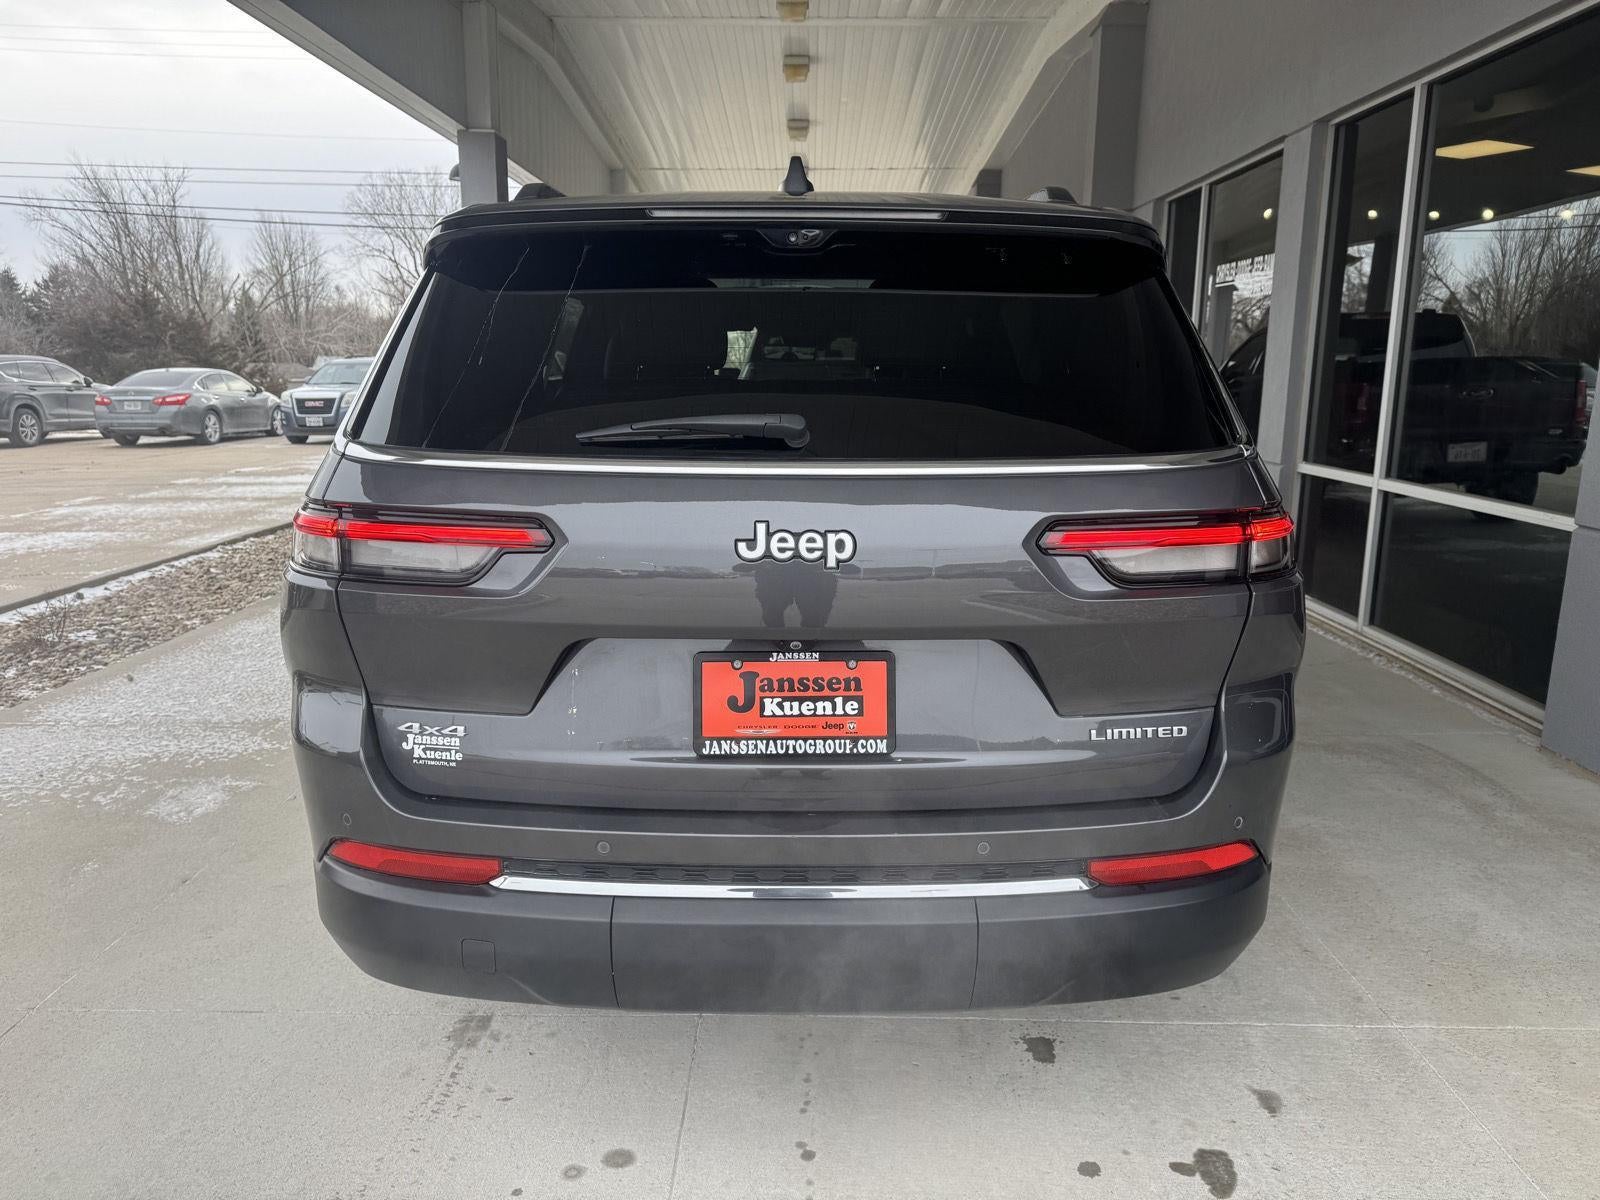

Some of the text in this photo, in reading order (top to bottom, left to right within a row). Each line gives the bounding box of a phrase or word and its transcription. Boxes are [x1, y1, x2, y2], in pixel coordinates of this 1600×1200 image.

[735, 520, 857, 570] Jeep
[769, 652, 820, 662] JANSSEN
[726, 671, 863, 714] Janssen
[762, 697, 859, 717] Kuenle
[397, 722, 468, 737] 4x4
[821, 721, 845, 731] Jeep
[1089, 725, 1188, 741] LIMITED
[401, 733, 460, 750] Janssen
[702, 739, 888, 755] JANSSENAUTOGROUP.COM
[412, 744, 463, 761] Kuenle
